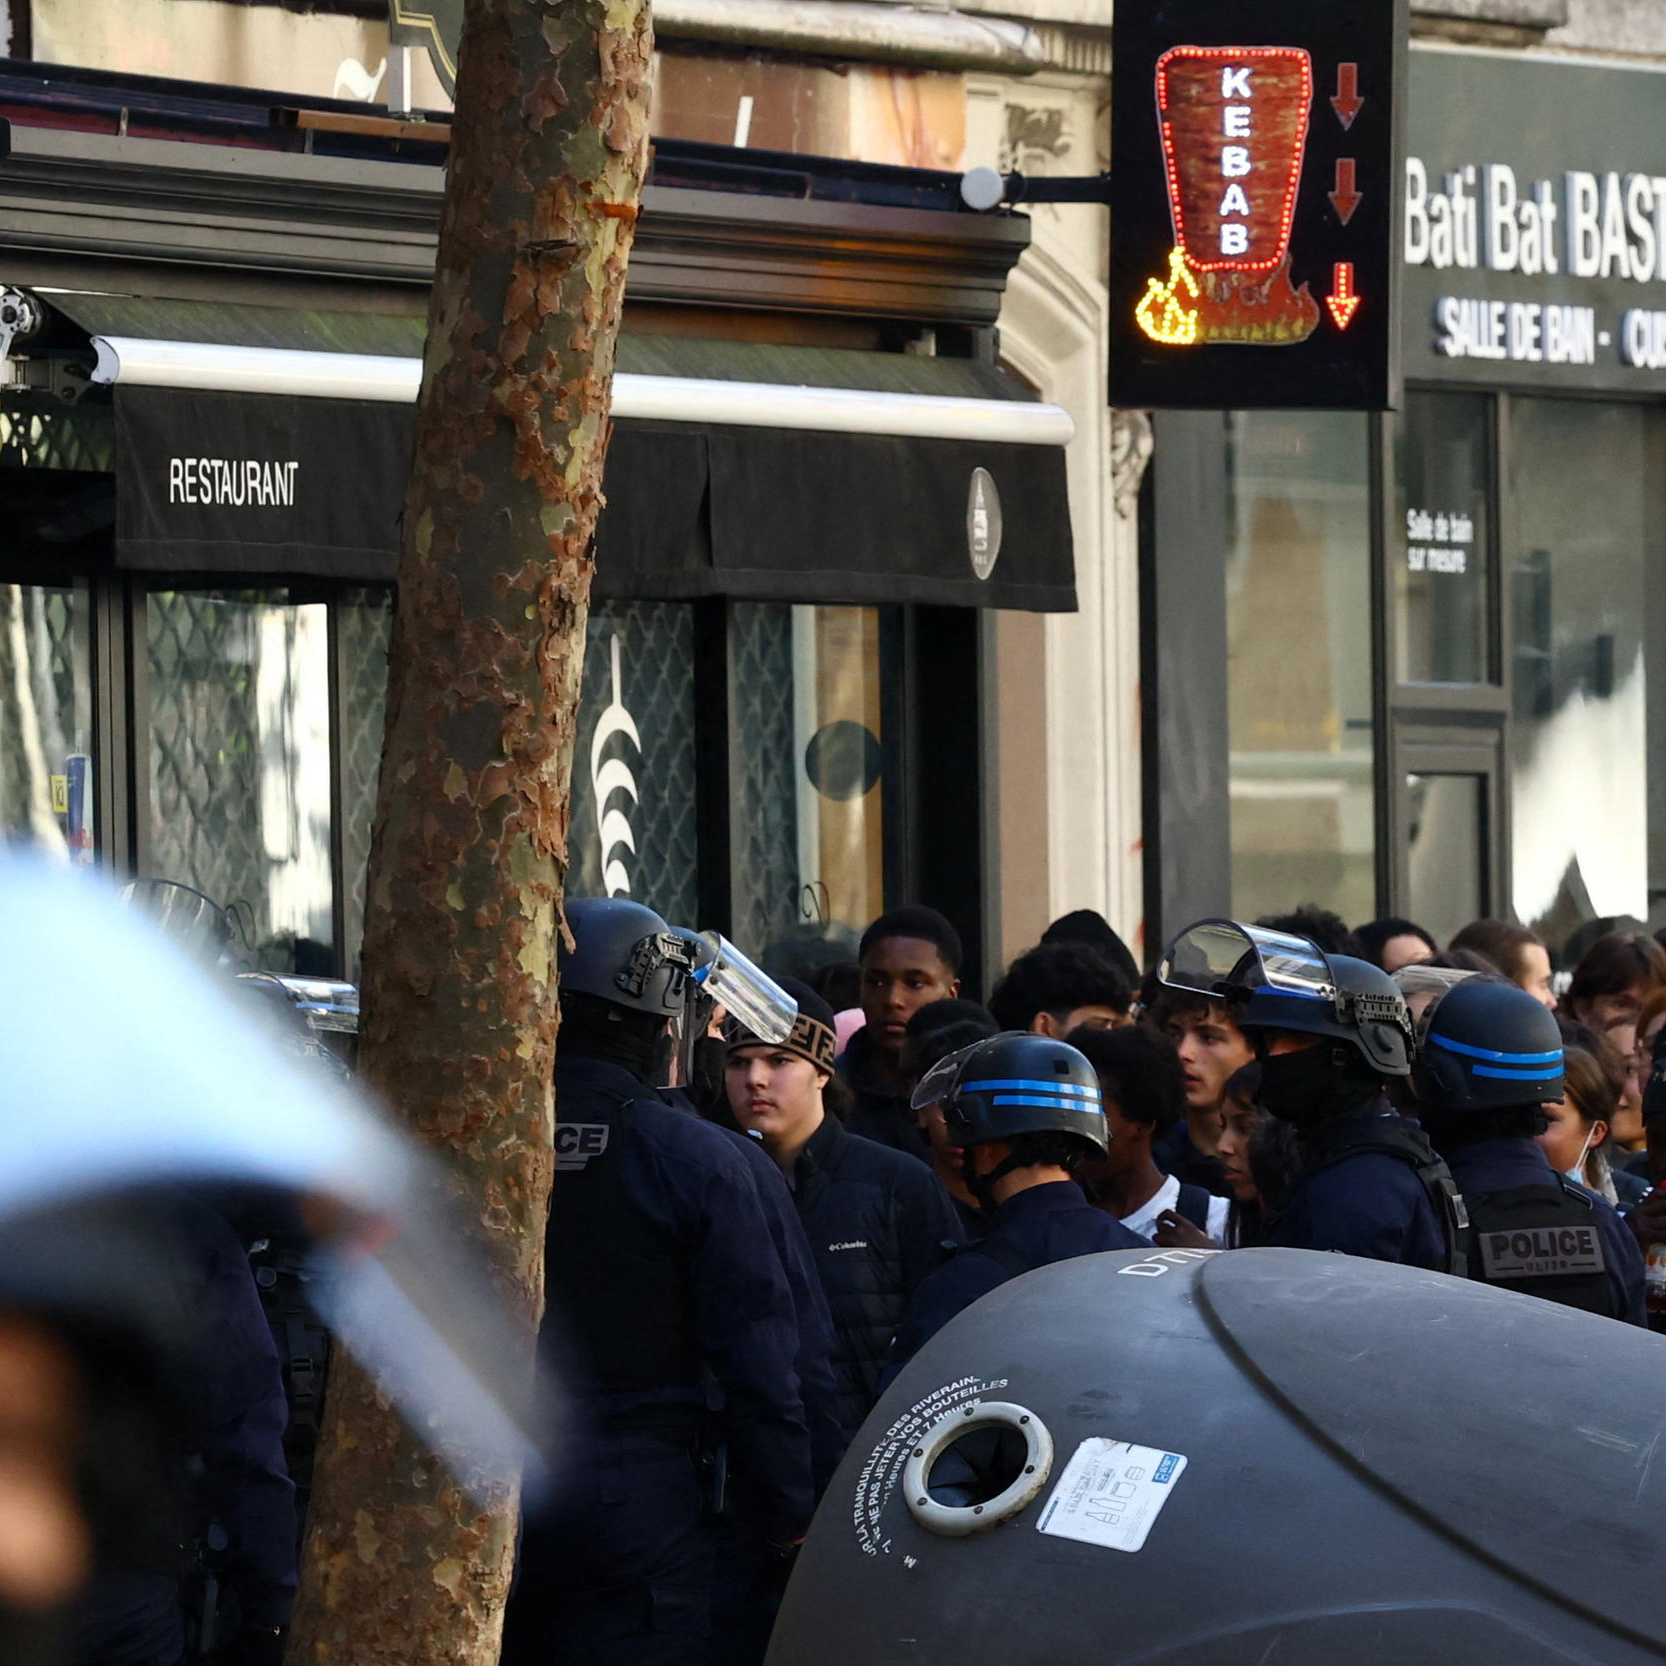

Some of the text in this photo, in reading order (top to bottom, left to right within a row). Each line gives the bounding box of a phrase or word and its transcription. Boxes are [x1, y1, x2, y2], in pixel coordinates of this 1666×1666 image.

[1220, 67, 1251, 255] KEBAB
[1404, 156, 1478, 269] Bati
[1484, 163, 1558, 276] Bat
[1437, 297, 1507, 360] SALLE
[1507, 303, 1543, 361] DE
[169, 457, 299, 507] RESTAURANT
[1434, 510, 1449, 542] de
[1449, 511, 1473, 544] bain
[1407, 546, 1426, 571] sur
[1489, 1230, 1595, 1260] POLICE
[886, 1414, 912, 1437] DES
[911, 1375, 981, 1414] RIVERAIN
[868, 1480, 882, 1506] PAS
[877, 1440, 901, 1481] JETER
[898, 1418, 923, 1440] VOS
[922, 1378, 1009, 1418] BOUTEILLES
[906, 1431, 924, 1447] ET
[923, 1422, 933, 1431] 7
